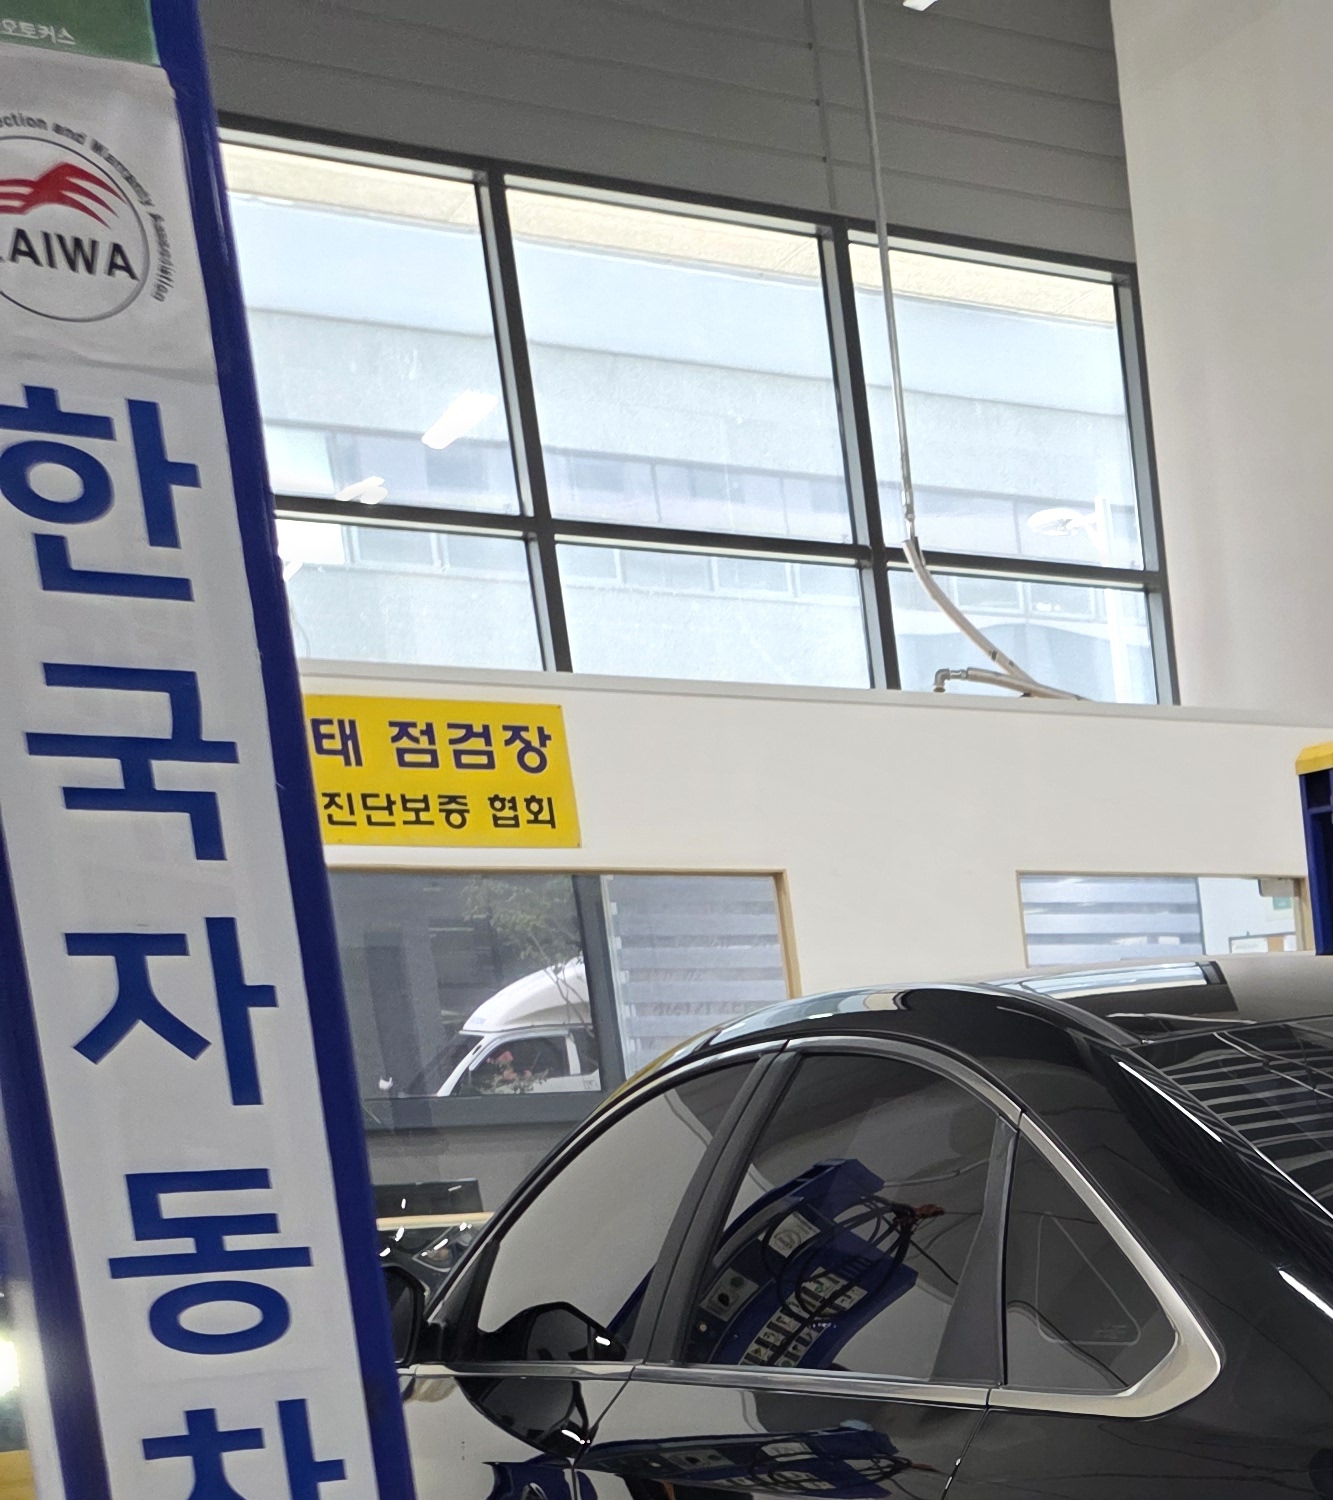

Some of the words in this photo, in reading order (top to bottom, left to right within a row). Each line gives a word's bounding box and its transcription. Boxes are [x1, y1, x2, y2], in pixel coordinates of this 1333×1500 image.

[0, 228, 139, 281] AIWA
[388, 719, 552, 774] 점검장
[320, 791, 471, 830] 진단보증
[487, 793, 557, 830] 협회
